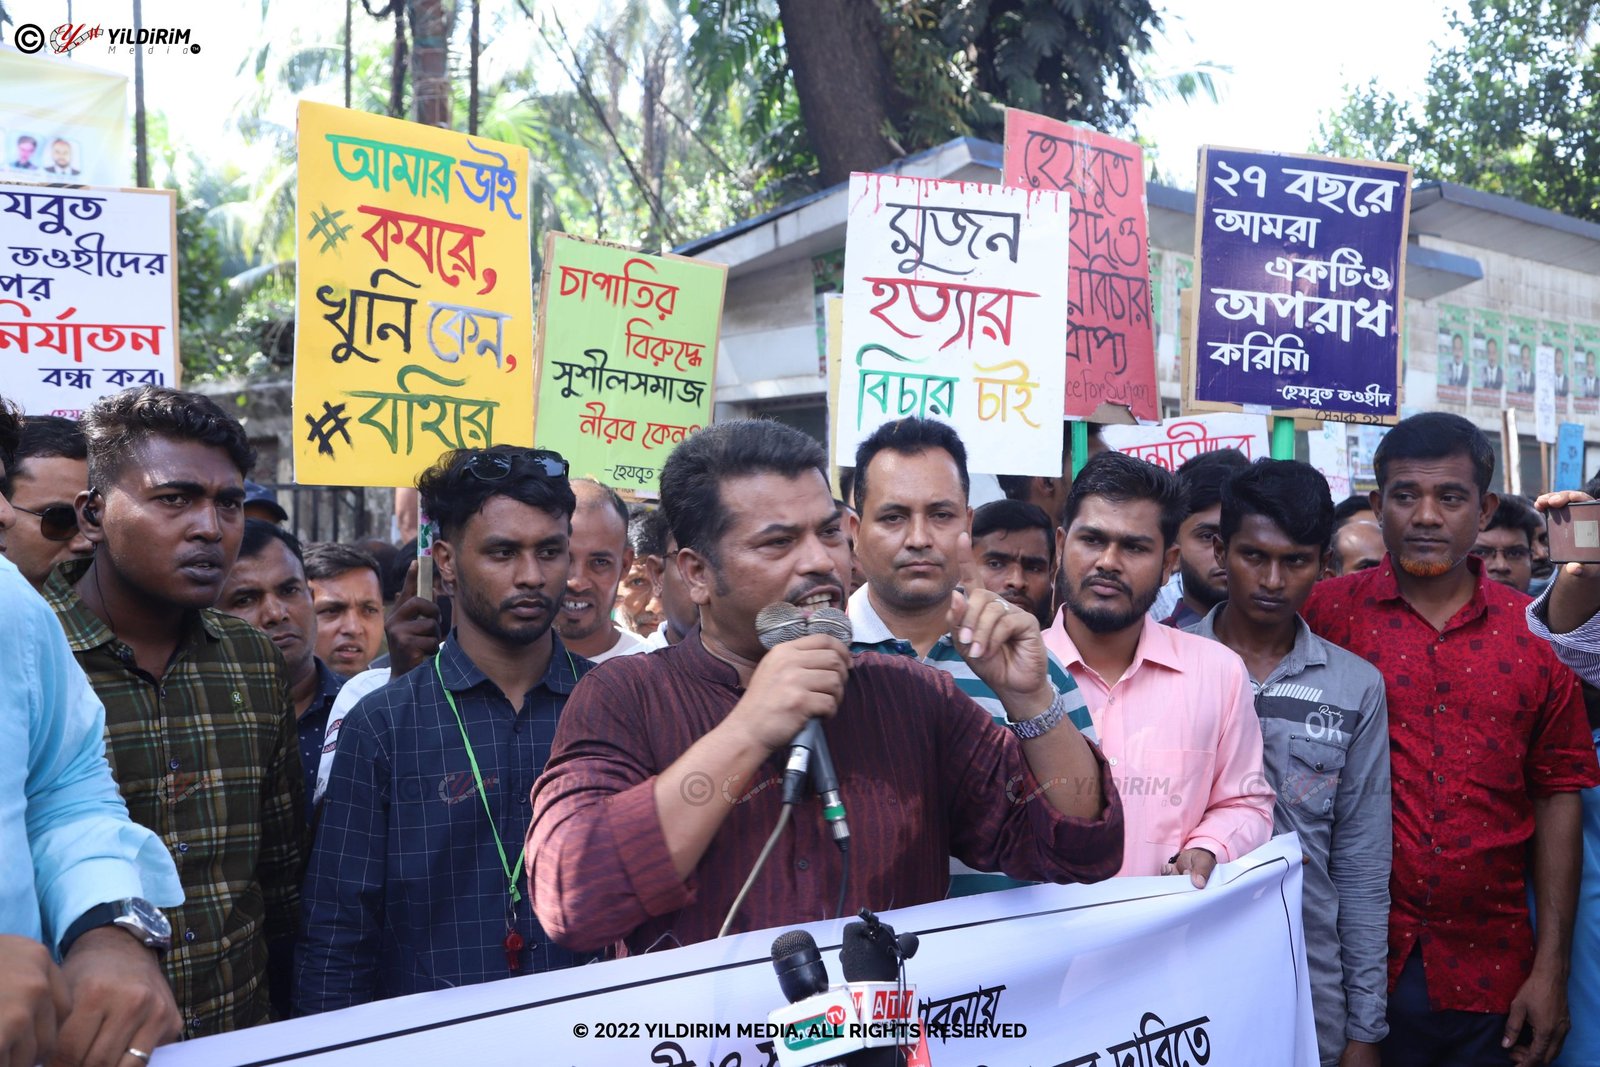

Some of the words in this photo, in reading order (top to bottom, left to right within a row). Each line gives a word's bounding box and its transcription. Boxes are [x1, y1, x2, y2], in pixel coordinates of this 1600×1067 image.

[325, 134, 456, 204] আমার
[455, 139, 522, 220] ভাই
[1213, 160, 1267, 198] ২৭
[1281, 167, 1400, 217] বছরে
[0, 192, 107, 236] যবুত
[1212, 207, 1322, 249] আমরা
[8, 232, 168, 278] তওহীদের
[886, 202, 1020, 275] সুজন
[559, 258, 680, 321] চাপাতির
[1265, 247, 1391, 290] একটিও
[316, 268, 422, 363] খুনি
[427, 301, 517, 373] কেন,
[863, 276, 1042, 351] হত্যার
[1211, 288, 1393, 343] অপরাধ
[625, 318, 706, 372] বিরুদ্ধে
[1207, 331, 1309, 375] করিনি।
[38, 368, 94, 389] বন্ধ
[856, 343, 960, 431] বিচার
[973, 359, 1041, 429] চাই
[1338, 383, 1391, 407] তওহীদ
[579, 402, 637, 444] নীরব
[1305, 711, 1344, 742] OK
[828, 1009, 844, 1023] TV
[873, 991, 913, 1019] ATV
